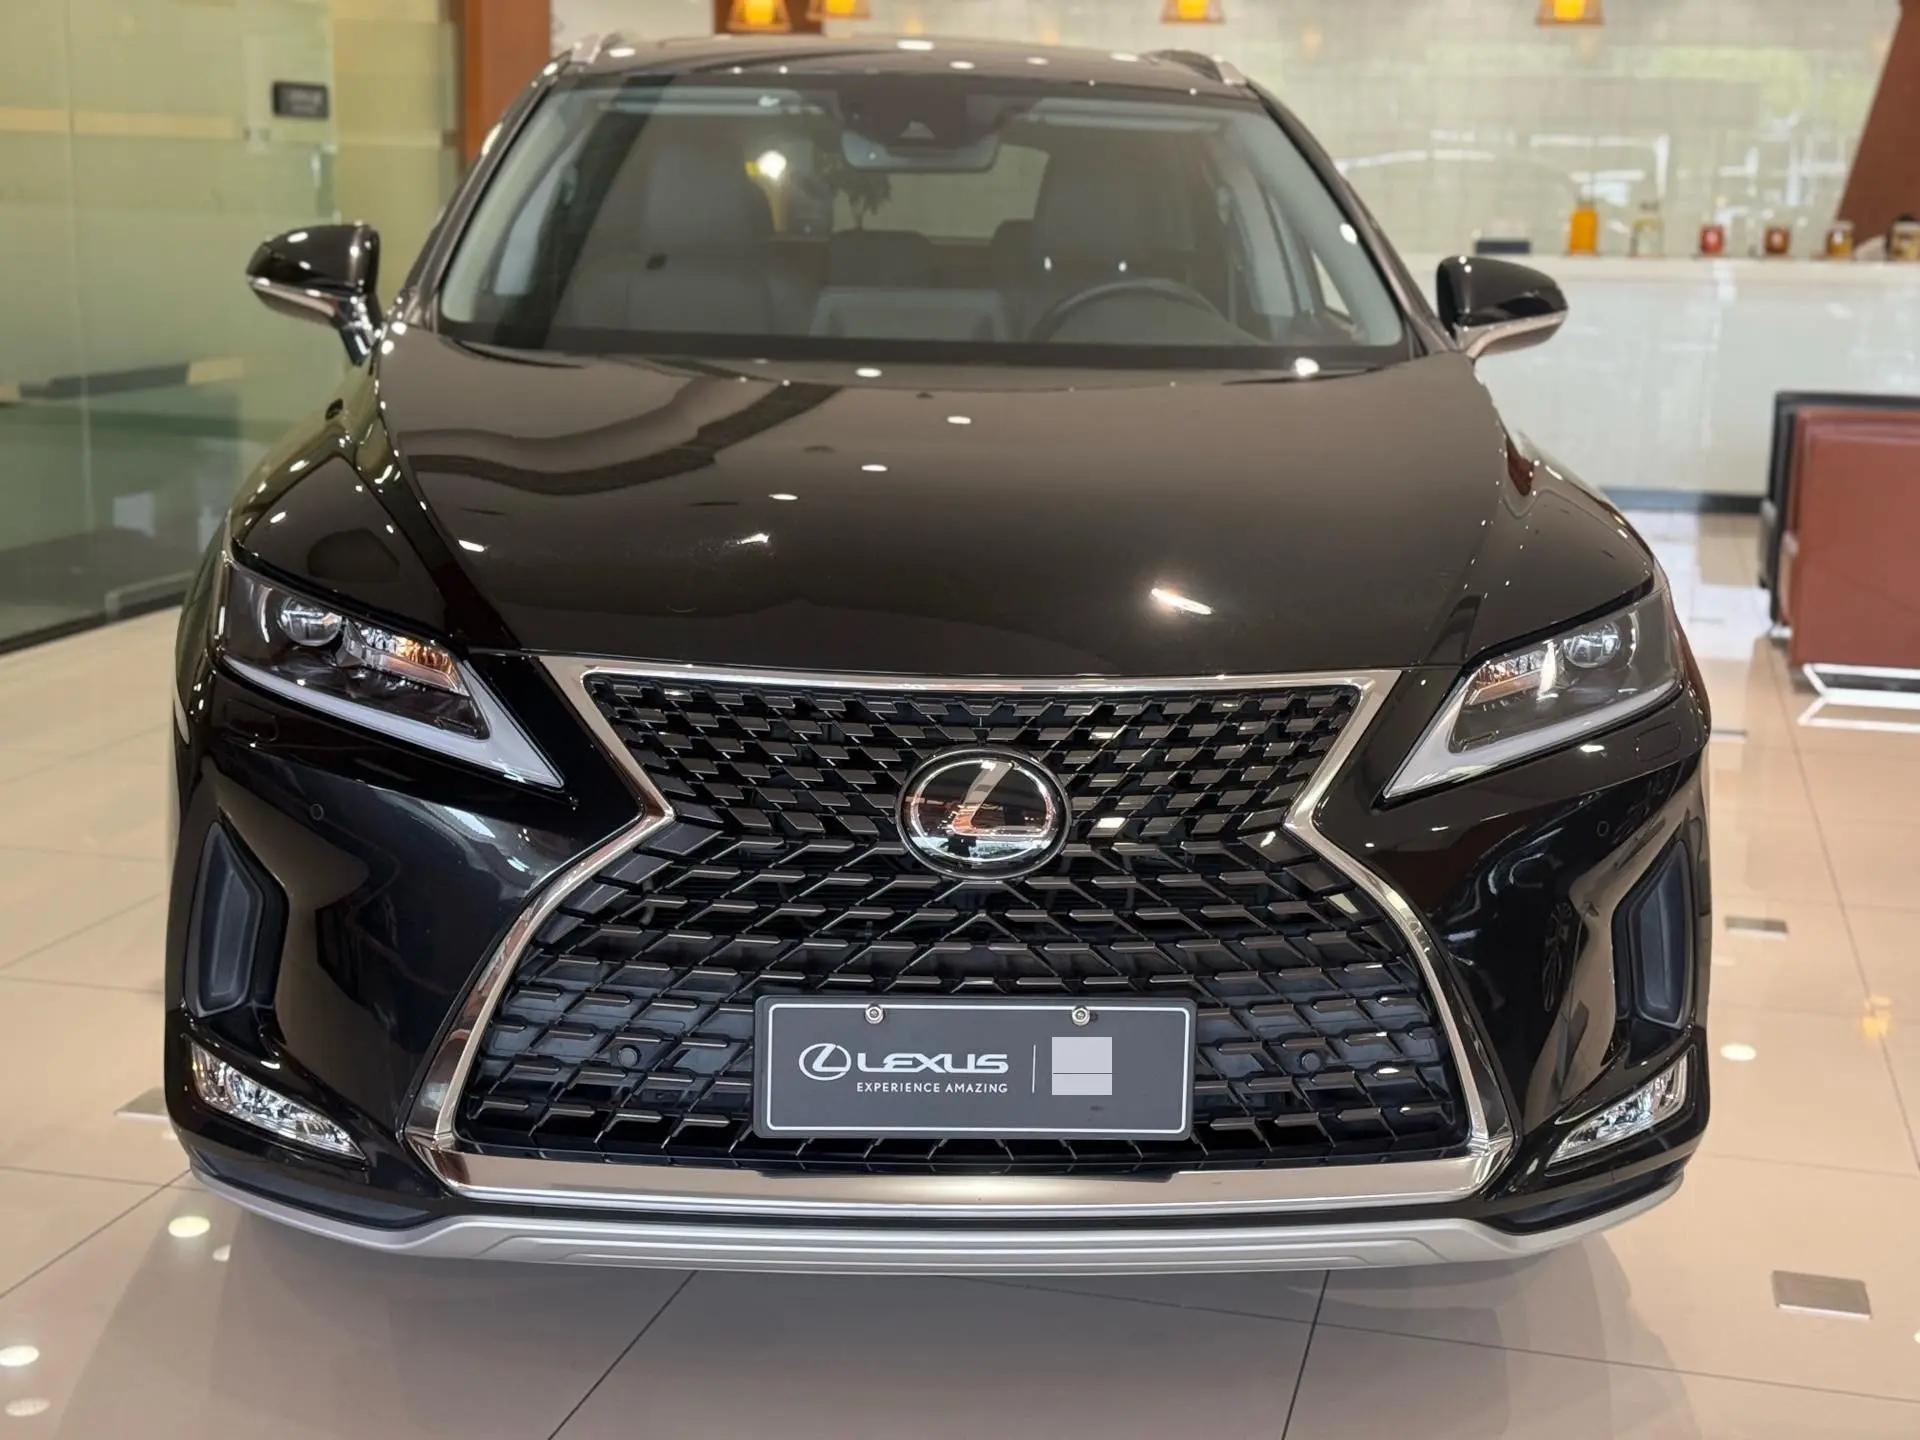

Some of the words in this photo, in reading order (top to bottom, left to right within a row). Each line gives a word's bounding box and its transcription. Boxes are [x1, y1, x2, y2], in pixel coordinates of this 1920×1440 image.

[857, 1052, 1009, 1074] LEXUS
[856, 1082, 941, 1093] EXPERIENCE
[945, 1083, 1008, 1094] AMAZING
